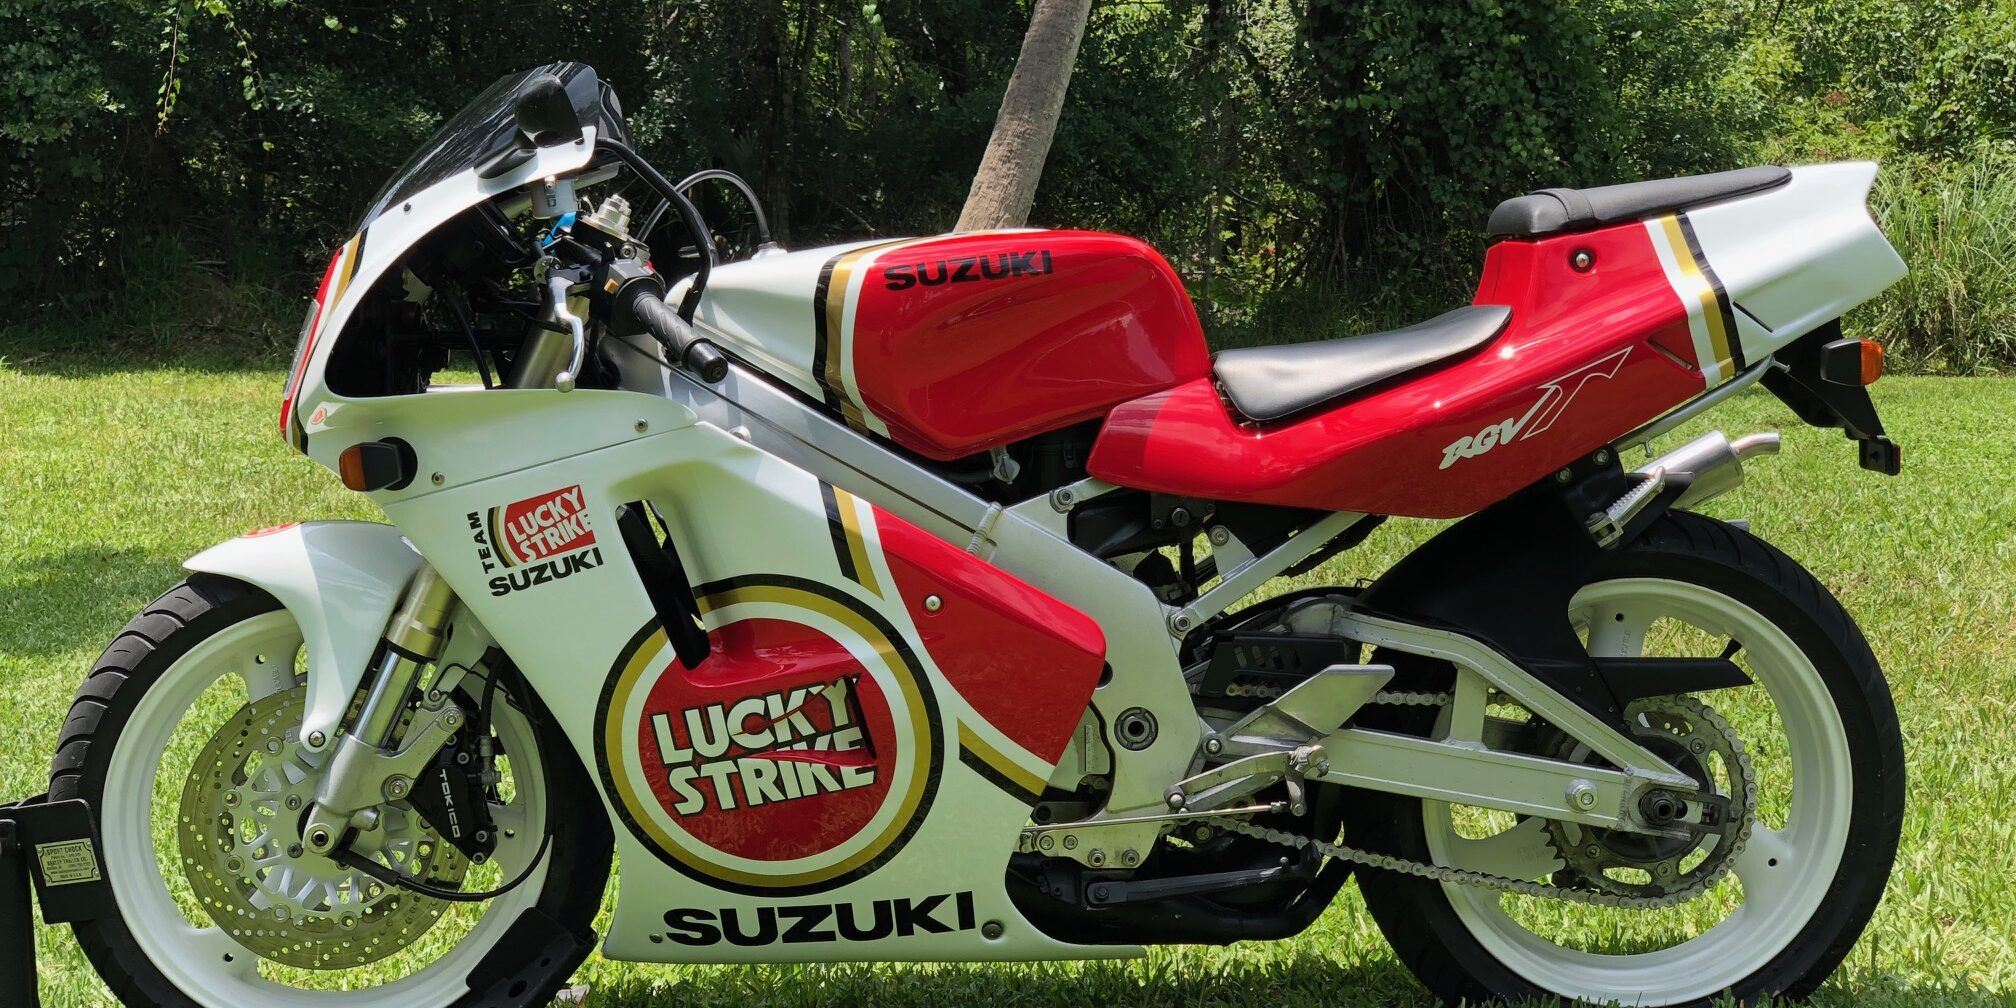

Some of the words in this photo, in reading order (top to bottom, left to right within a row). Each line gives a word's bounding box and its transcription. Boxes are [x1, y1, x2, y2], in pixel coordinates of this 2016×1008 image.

[884, 249, 1053, 290] SUZUKI
[1438, 385, 1557, 470] RGV
[467, 511, 495, 574] TEAM
[507, 486, 581, 543] LUCKY
[520, 510, 593, 562] STRIKE
[488, 547, 604, 597] SUZUKI
[650, 675, 860, 766] LUCKY
[668, 727, 876, 817] STRIKE
[440, 768, 460, 838] TOKICO
[663, 891, 976, 947] SUZUKI
